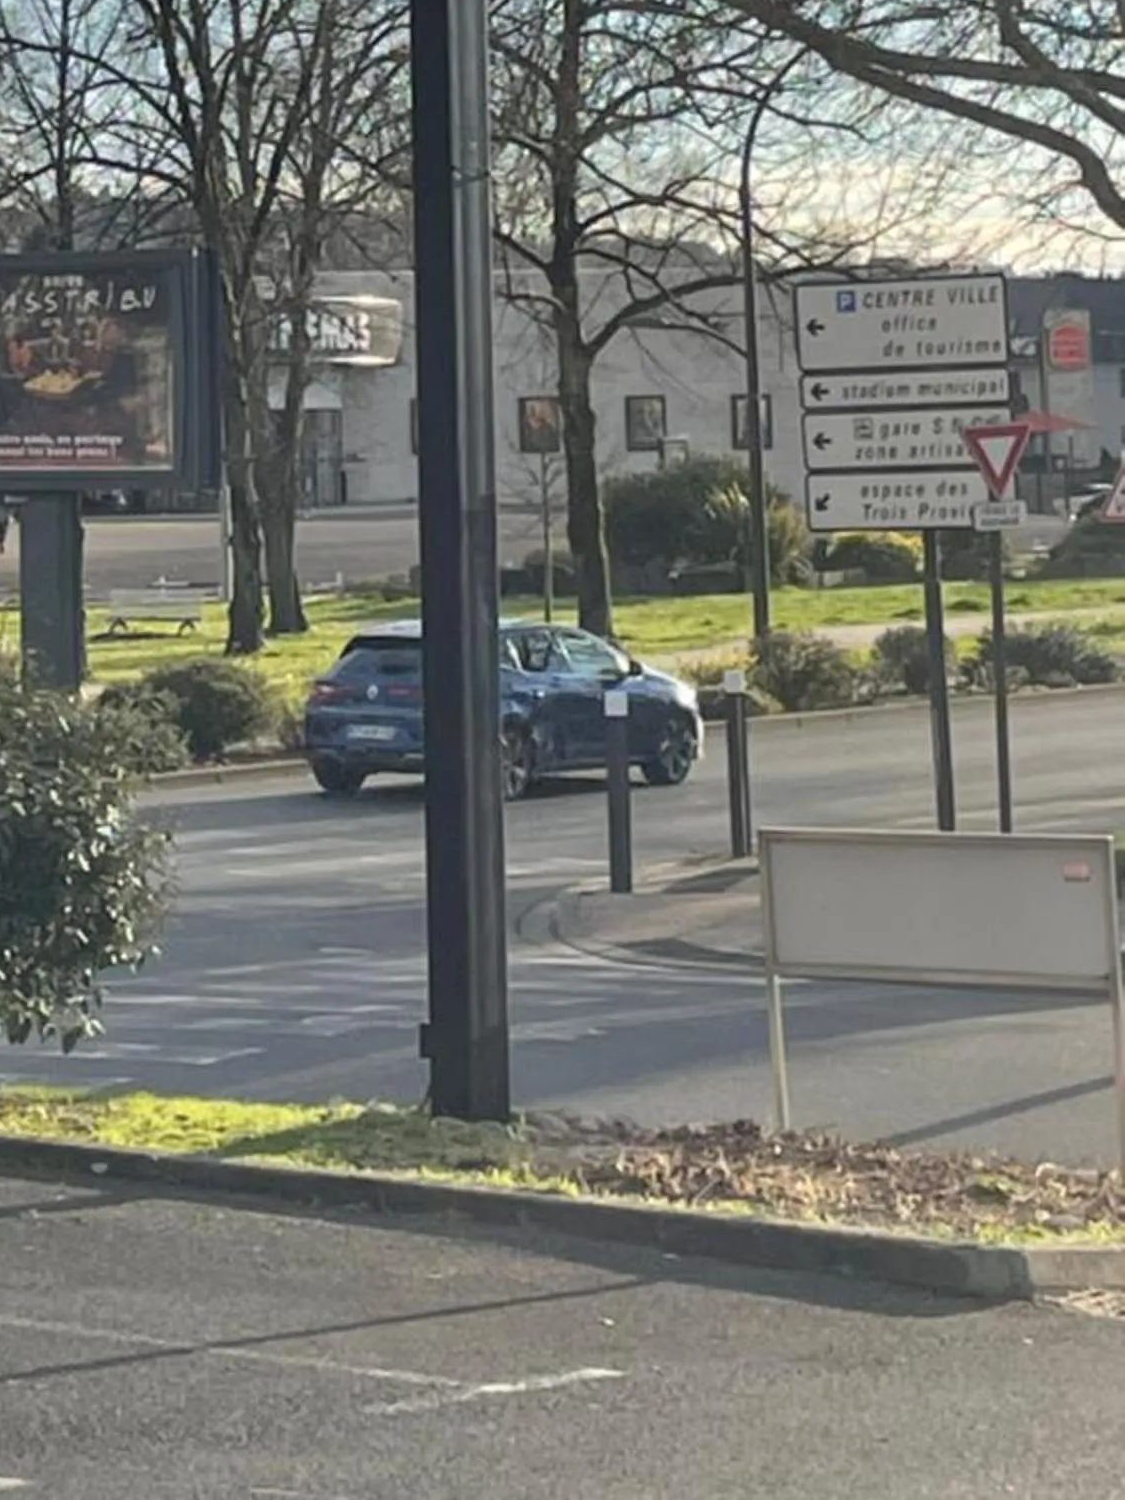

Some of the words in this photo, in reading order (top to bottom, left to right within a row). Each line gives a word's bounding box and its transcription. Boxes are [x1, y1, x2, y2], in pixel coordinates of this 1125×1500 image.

[862, 289, 936, 308] CENTRE
[947, 285, 999, 306] VILLE
[881, 315, 937, 333] office
[882, 340, 905, 358] de
[916, 339, 1002, 356] tourisme
[841, 382, 911, 399] stadium
[918, 377, 1005, 398] municipal
[878, 422, 922, 440] gare
[855, 444, 898, 461] zone
[860, 483, 925, 500] espace
[936, 479, 969, 497] des
[862, 503, 907, 522] Trois
